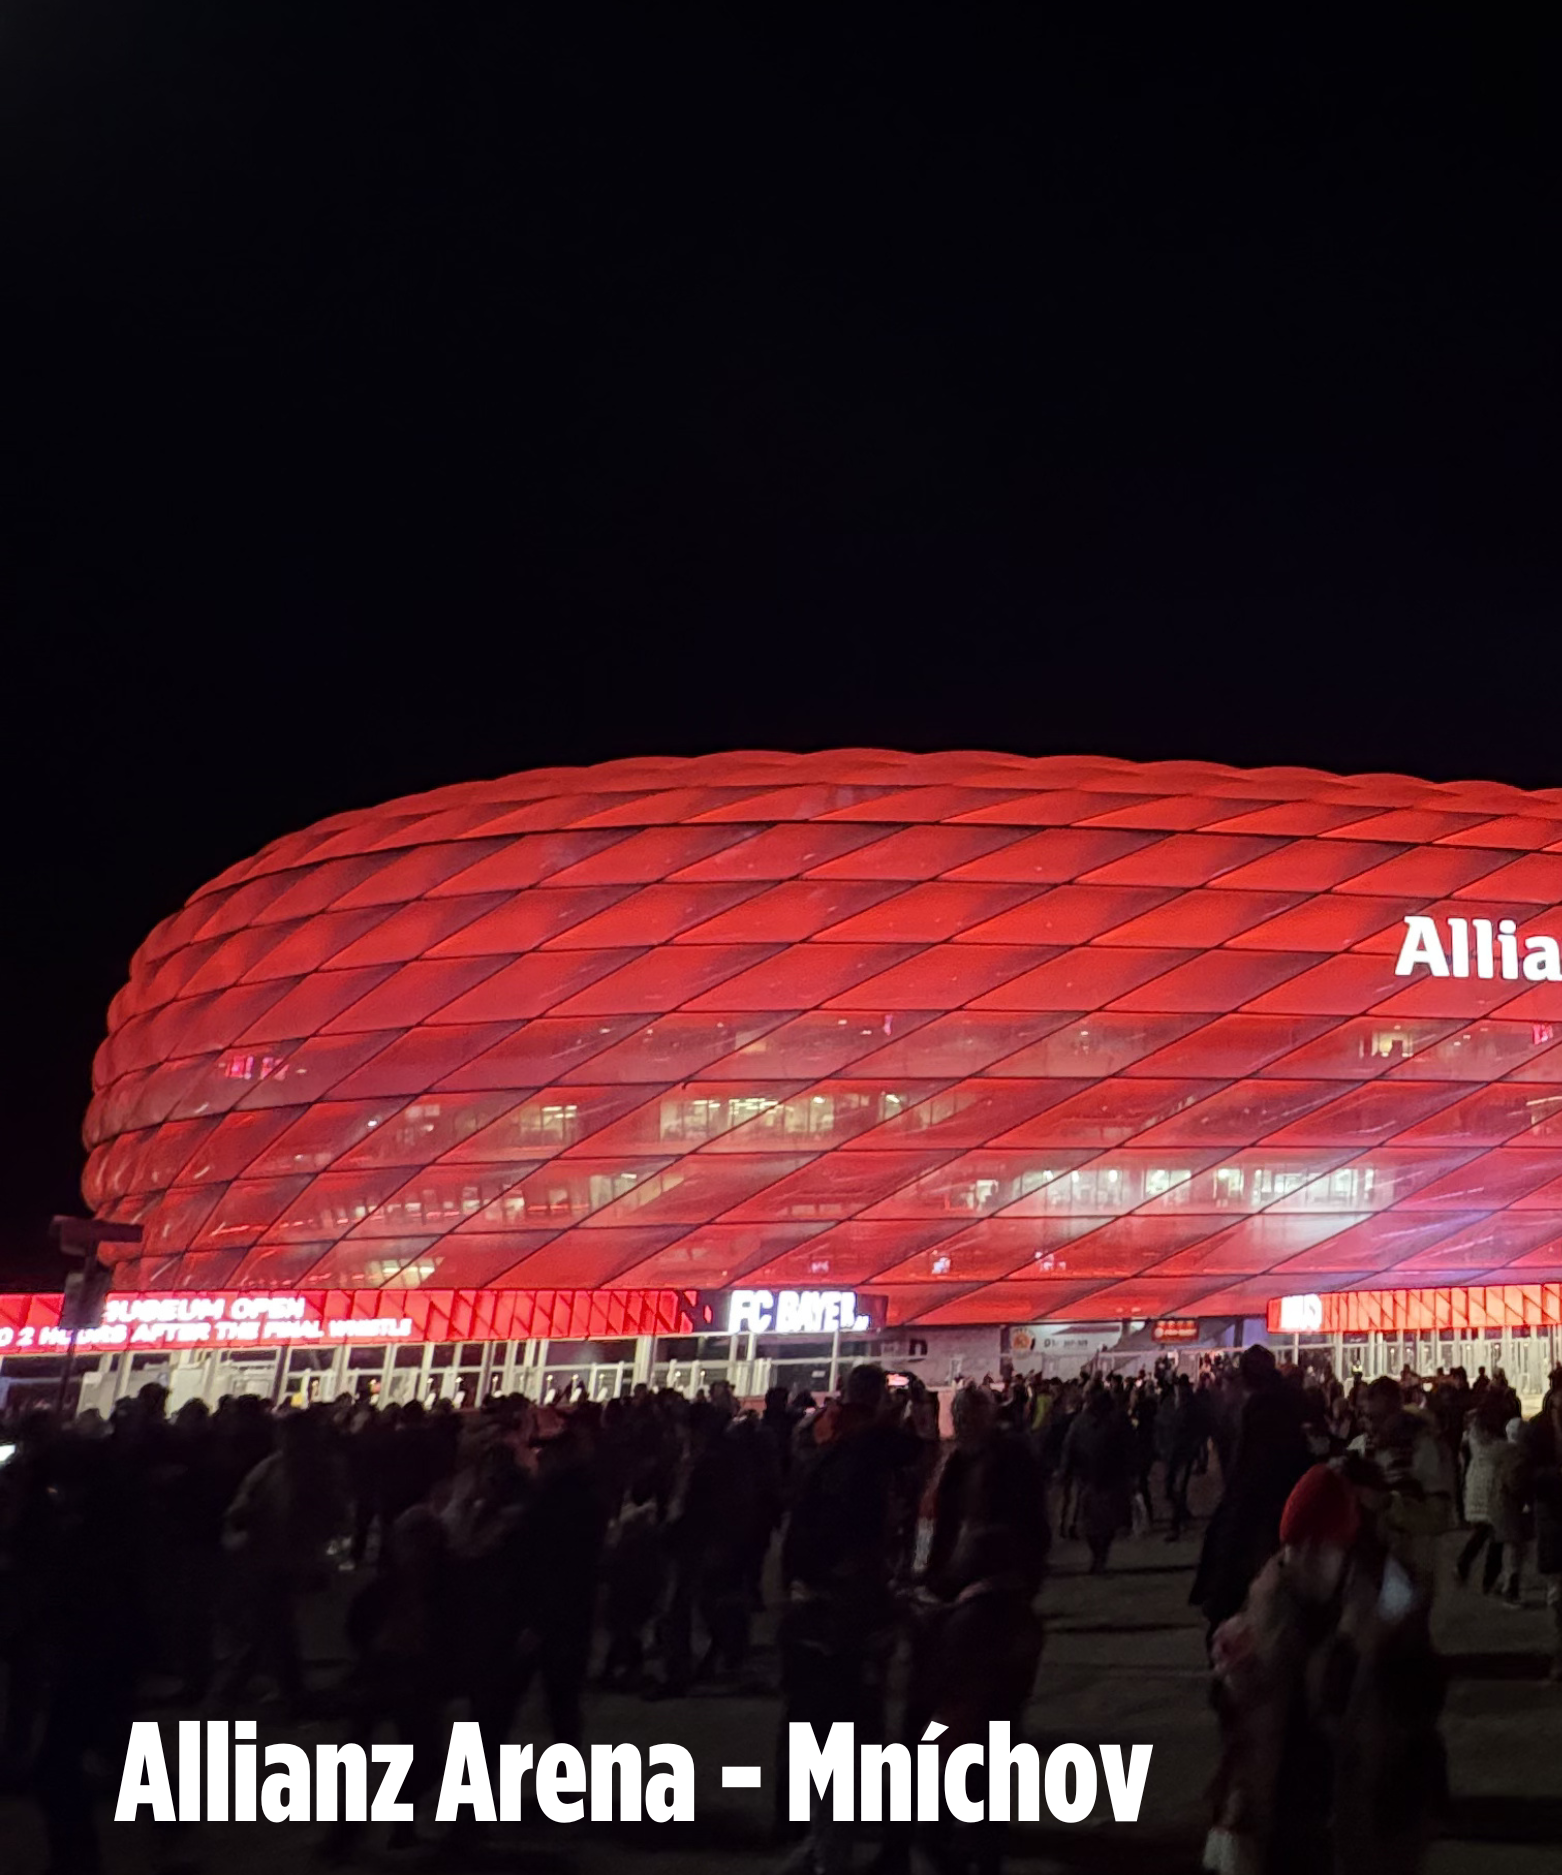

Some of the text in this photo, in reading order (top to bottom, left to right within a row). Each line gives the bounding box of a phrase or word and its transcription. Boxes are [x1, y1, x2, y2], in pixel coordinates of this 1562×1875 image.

[231, 1298, 304, 1320] OPEN
[728, 1290, 773, 1333] FC
[16, 1327, 35, 1346] 2
[130, 1322, 210, 1342] AFTER
[214, 1321, 260, 1341] THE
